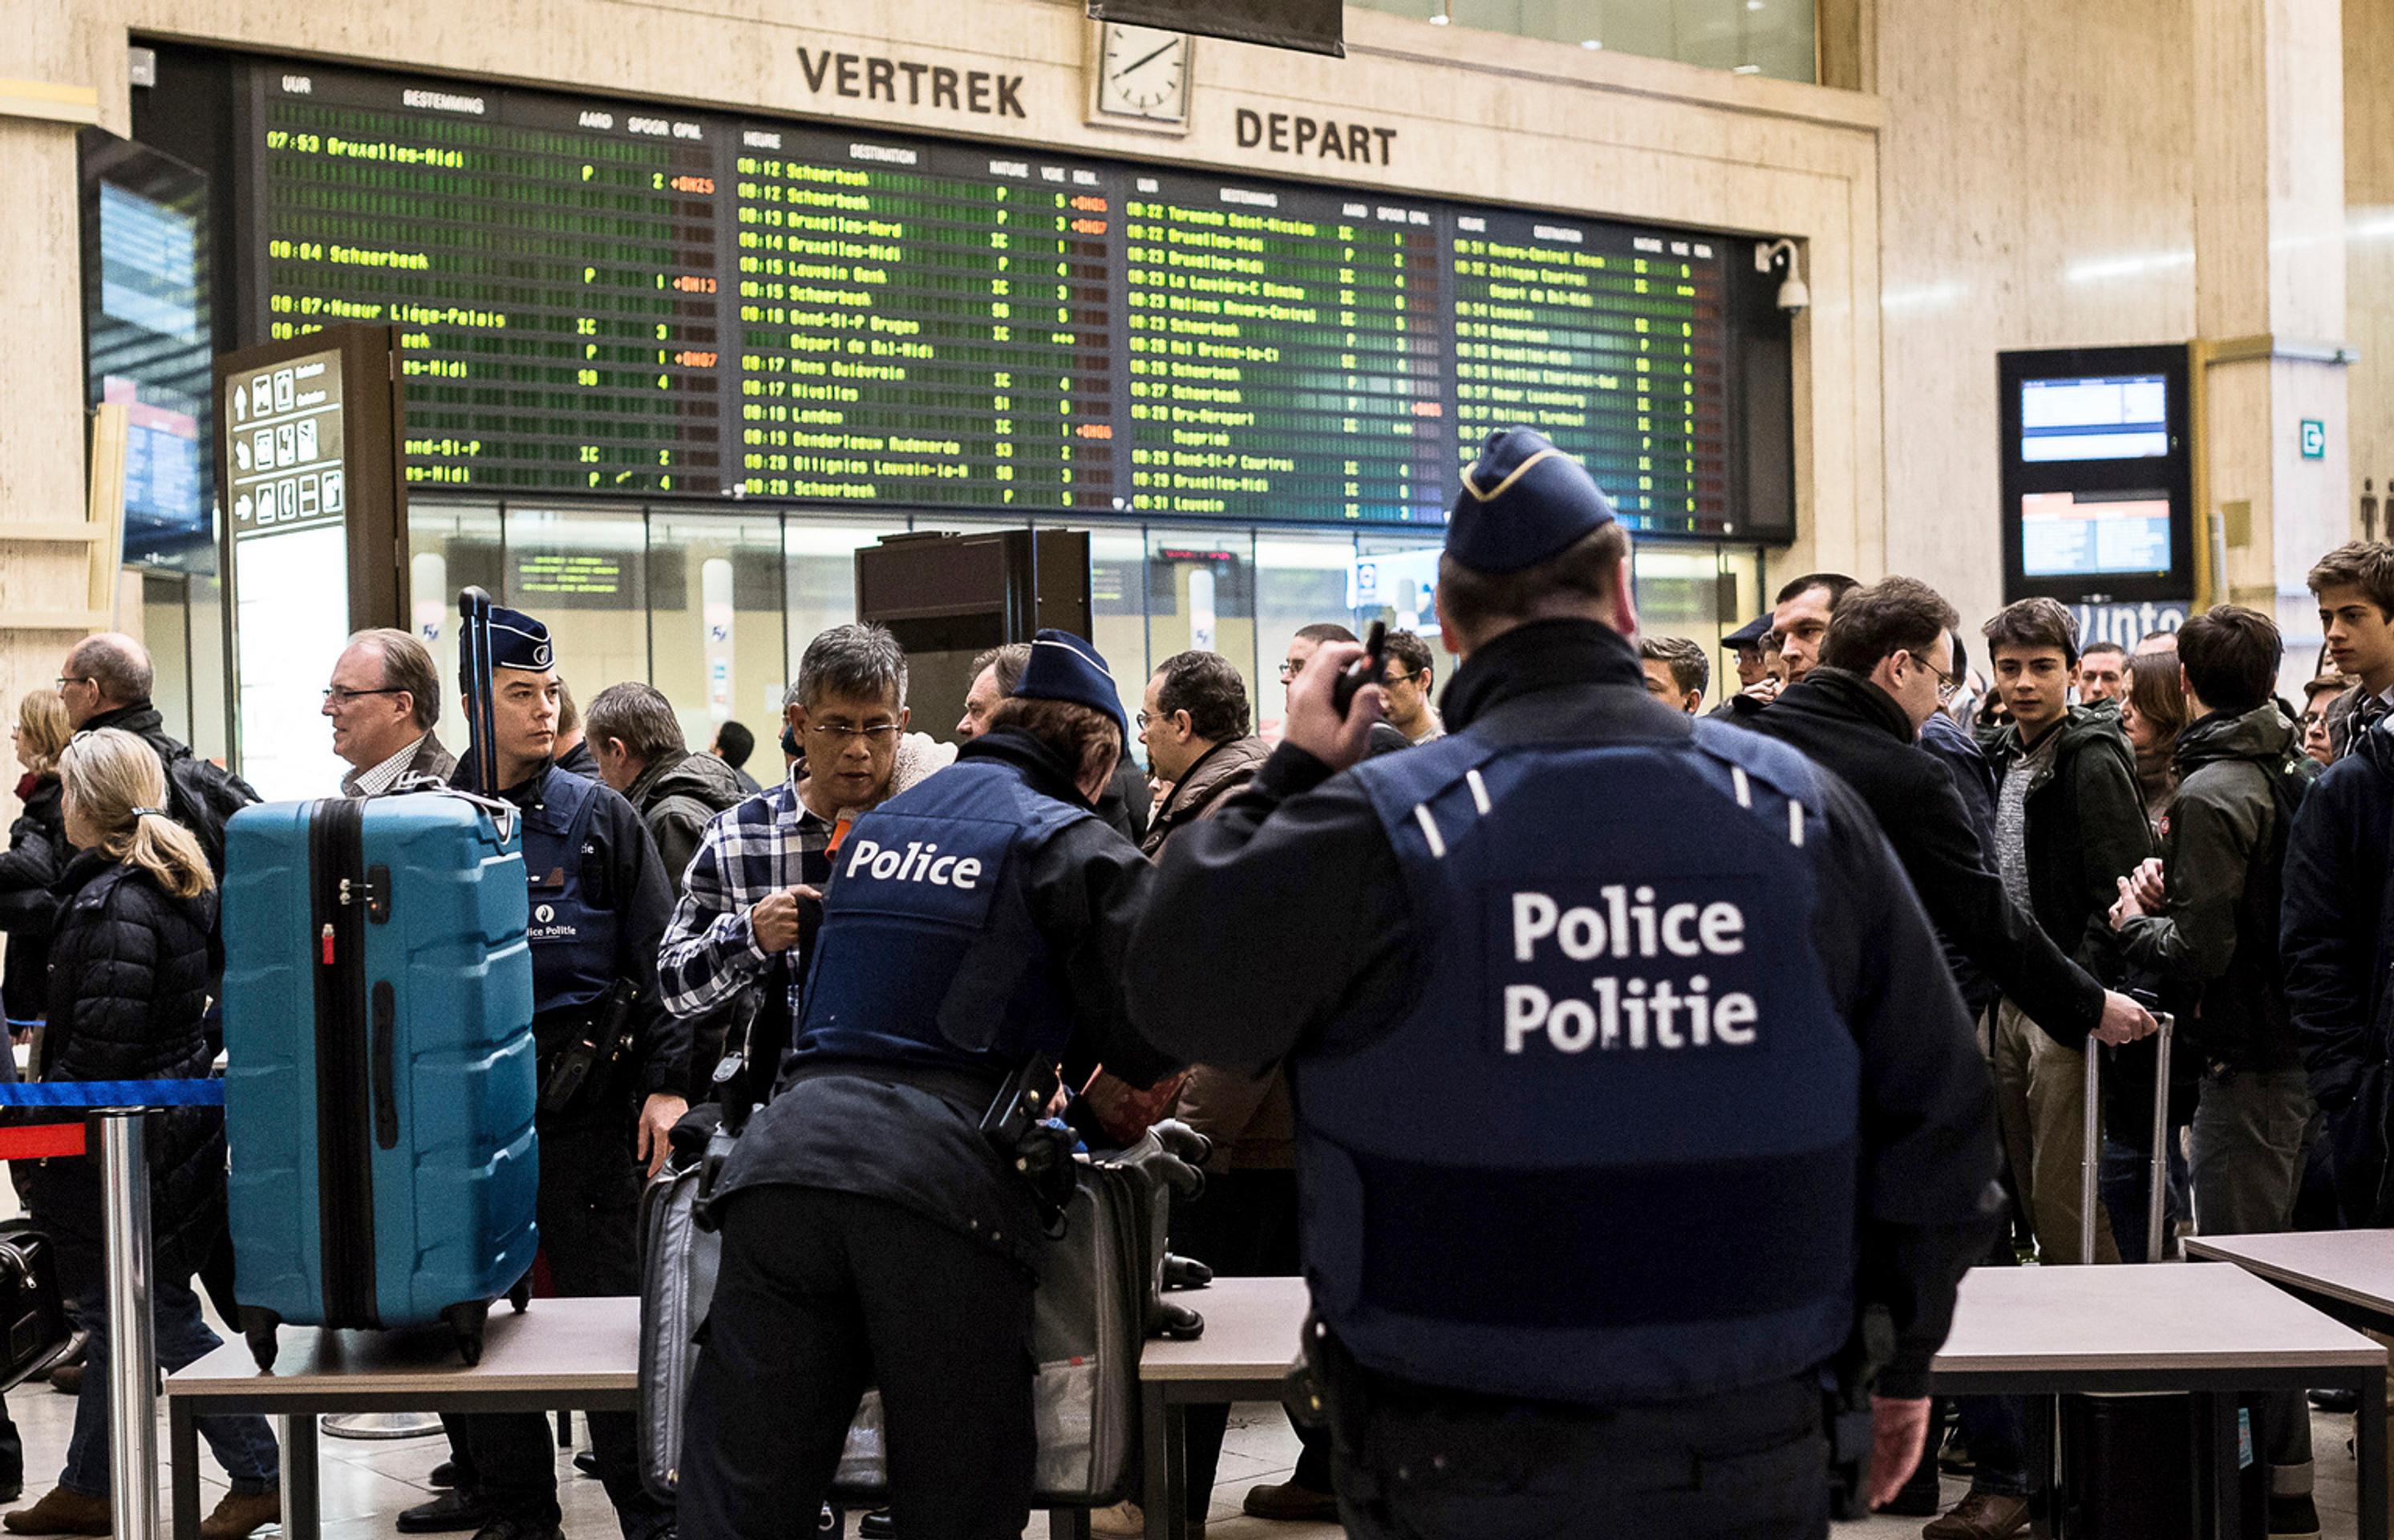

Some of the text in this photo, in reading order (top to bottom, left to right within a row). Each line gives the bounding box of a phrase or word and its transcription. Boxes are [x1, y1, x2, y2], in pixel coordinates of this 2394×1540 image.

[796, 46, 1027, 120] VERTREK
[403, 89, 485, 115] BESTEMMING
[1236, 108, 1398, 167] DEPART
[267, 131, 319, 153] 07:53
[327, 137, 463, 168] Bruxelles-Midi
[582, 165, 593, 181] P
[653, 172, 663, 189] 2
[330, 245, 429, 270] Schaerbeek
[585, 267, 596, 283] P
[656, 324, 666, 340] 3
[586, 344, 597, 359] P
[658, 375, 668, 390] 4
[659, 450, 669, 466] 2
[589, 472, 670, 490] P 4
[845, 839, 982, 890] Police
[526, 926, 577, 937] lice Politie
[1512, 885, 1745, 962] Police
[1504, 975, 1759, 1055] Politie
